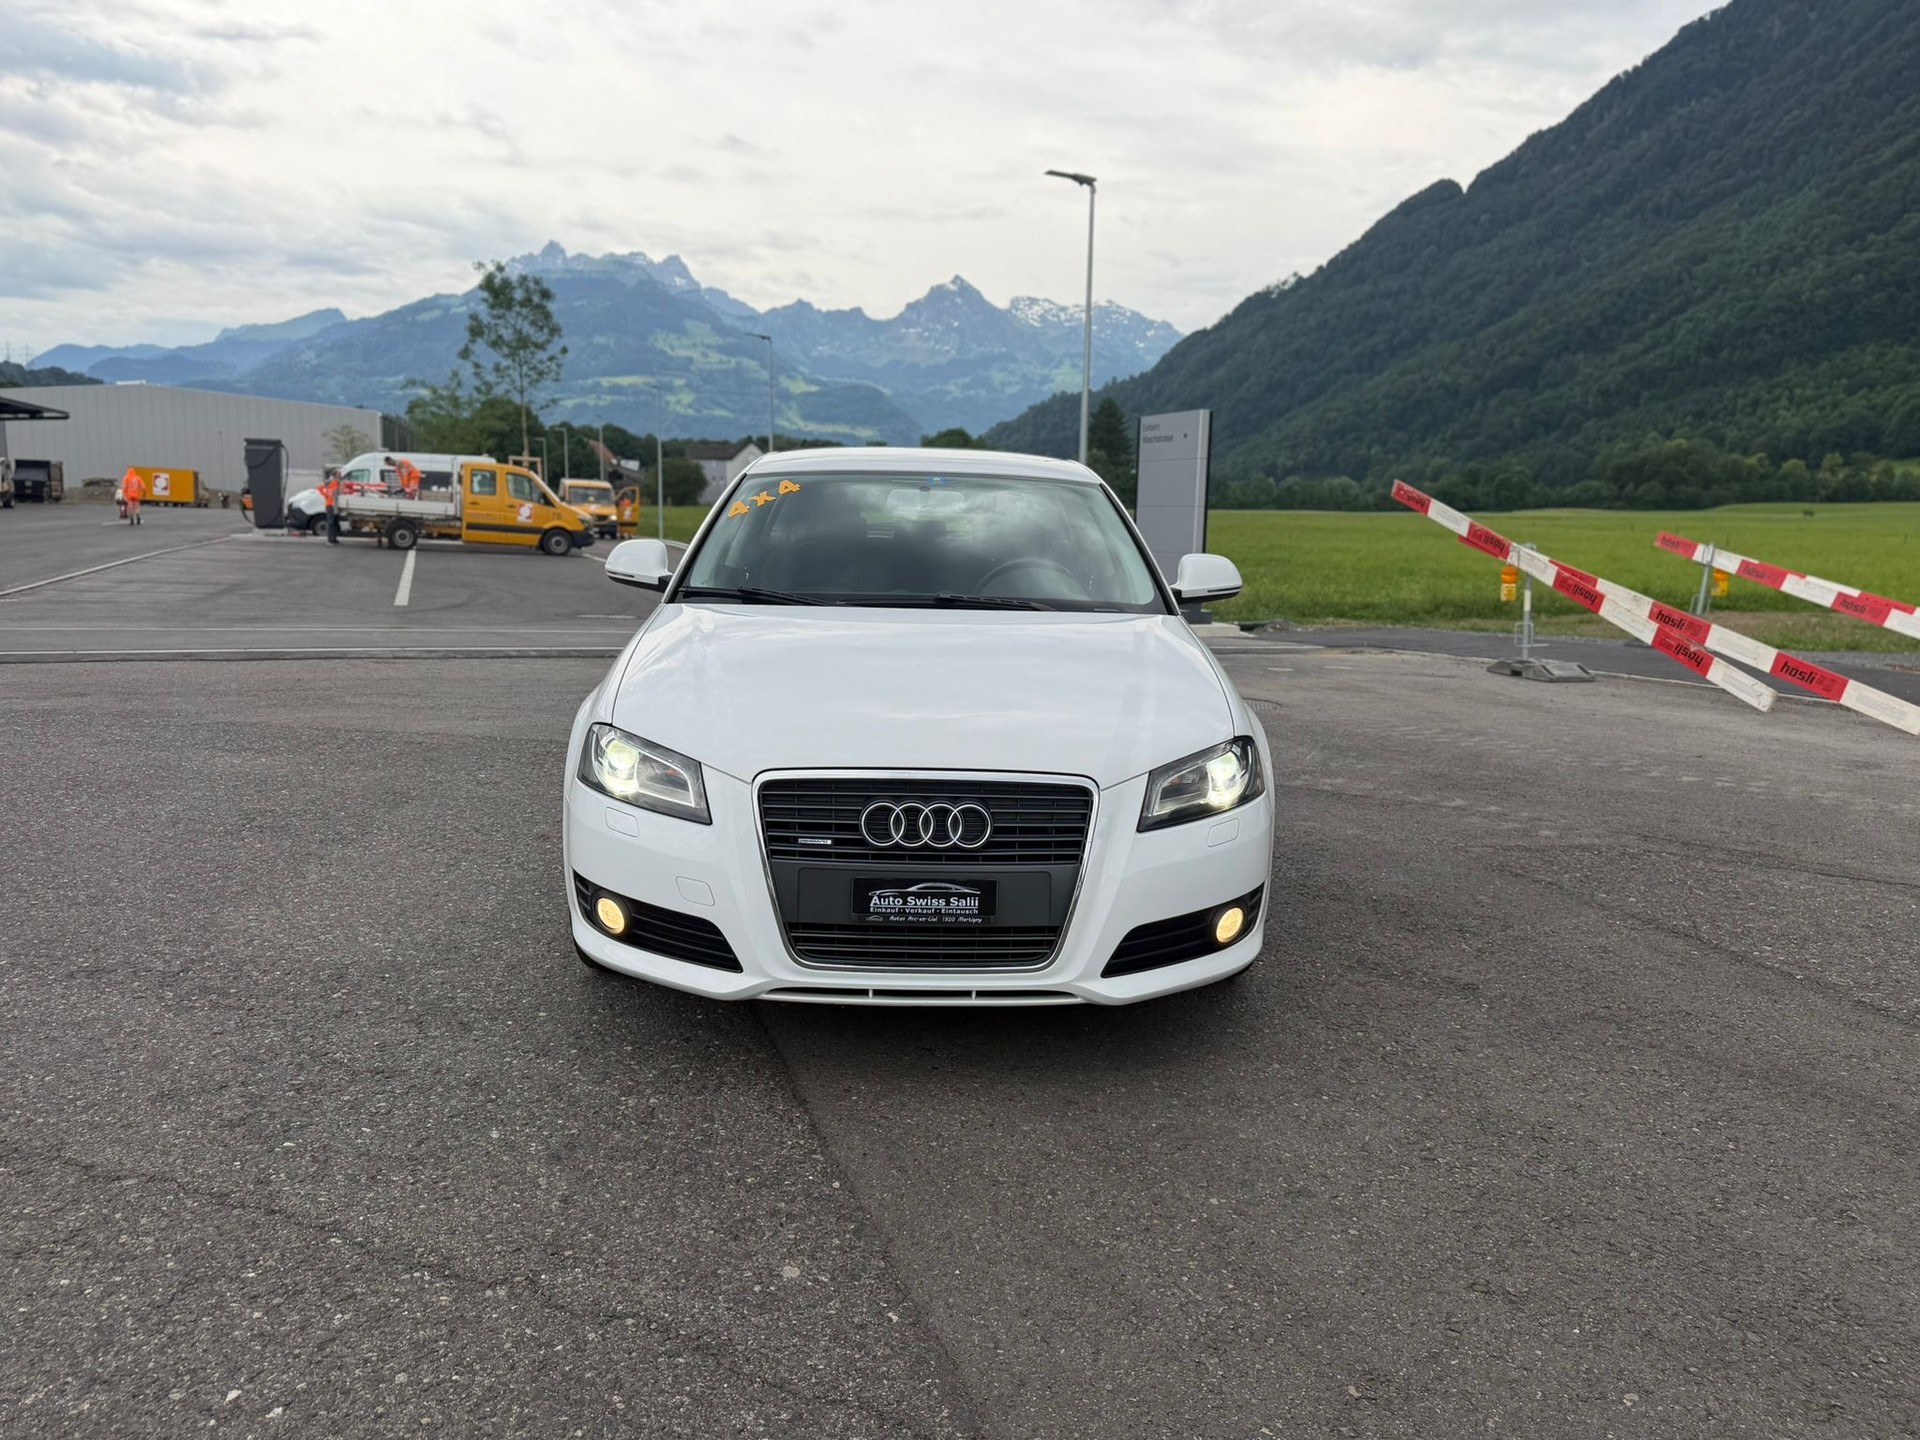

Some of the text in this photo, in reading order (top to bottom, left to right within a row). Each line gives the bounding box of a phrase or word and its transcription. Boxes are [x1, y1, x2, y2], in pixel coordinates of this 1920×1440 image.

[870, 896, 979, 907] Auto Swiss Salii
